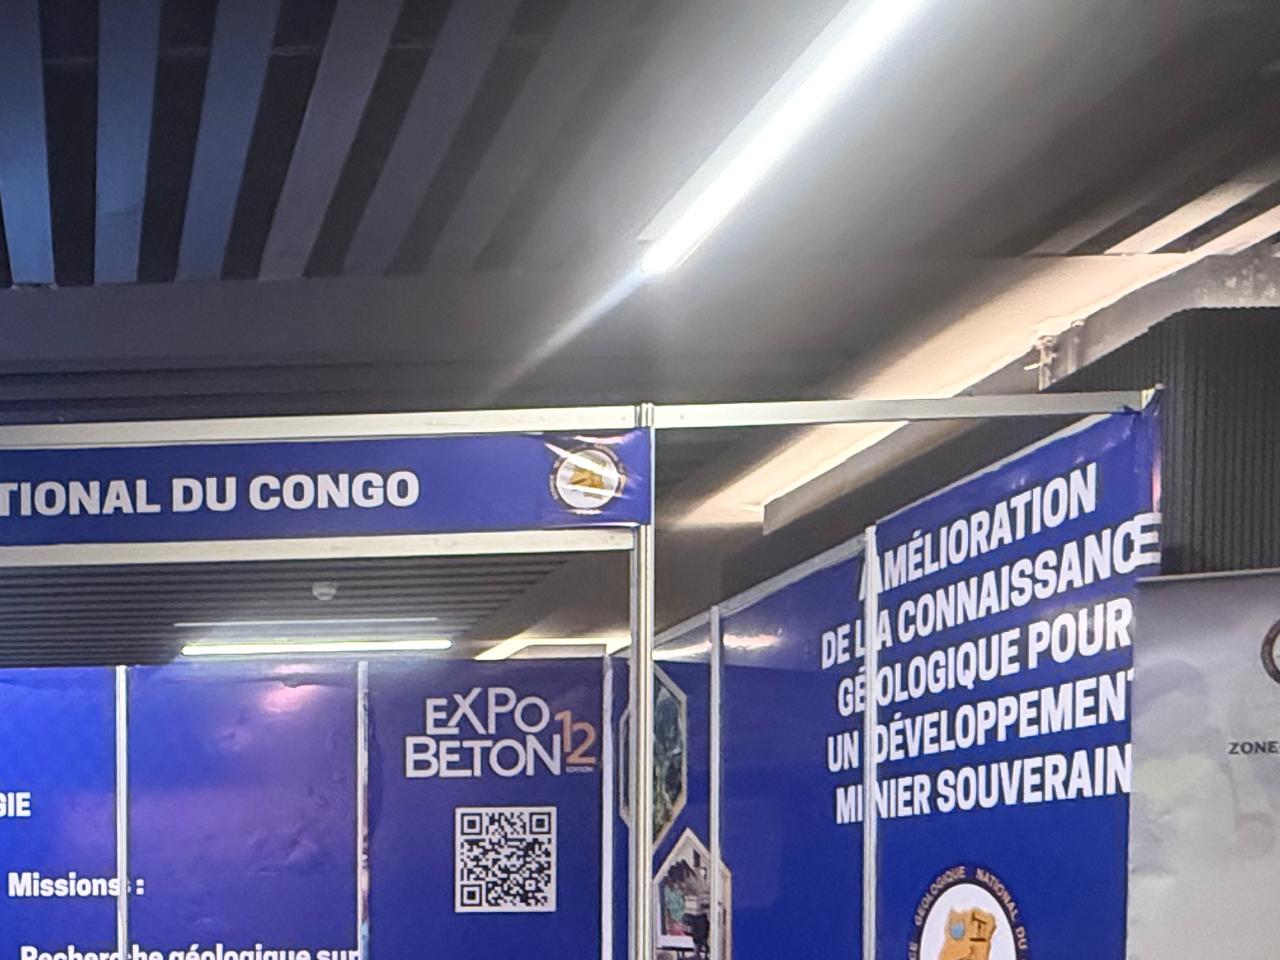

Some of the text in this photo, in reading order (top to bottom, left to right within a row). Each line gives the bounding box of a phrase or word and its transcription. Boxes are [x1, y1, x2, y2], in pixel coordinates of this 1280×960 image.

[171, 476, 238, 513] DU
[249, 471, 421, 513] CONGO
[859, 461, 1097, 602] AMÉLIORATION
[822, 511, 1161, 670] DE LA CONNAISSANCE
[838, 597, 1134, 717] GÉOLOGIQUE POUR
[405, 710, 596, 778] BETON 12
[425, 687, 550, 736] EXPO
[827, 668, 1135, 772] UN DÉVELOPPEMEN
[1228, 741, 1280, 755] ZONE
[836, 741, 1133, 825] MINIER SOUVERAIN
